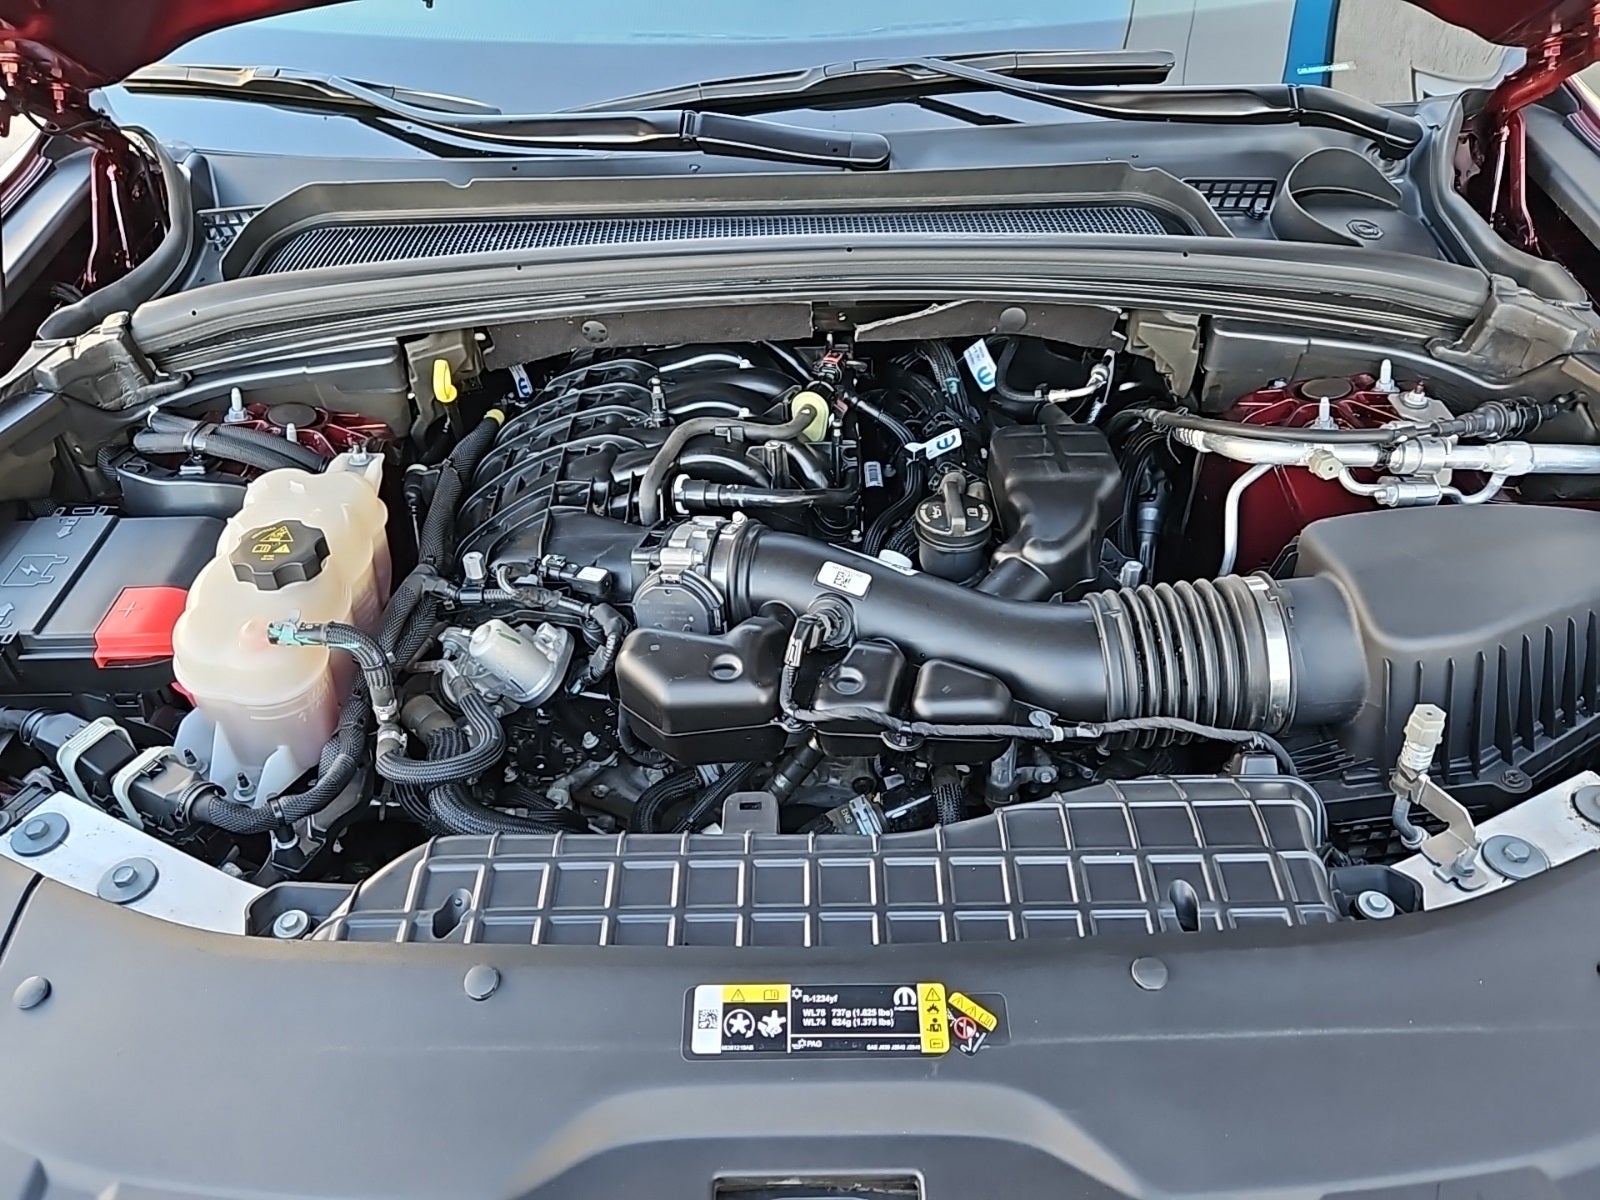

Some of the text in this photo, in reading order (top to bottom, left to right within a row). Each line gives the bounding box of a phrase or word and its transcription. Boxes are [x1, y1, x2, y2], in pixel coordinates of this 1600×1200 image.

[840, 808, 853, 824] ENG
[802, 994, 839, 1005] R-1234yf
[831, 1008, 852, 1018] 737g
[878, 1008, 894, 1018] lbs)
[802, 1017, 894, 1028] WL74 624g (1.375 lbs)
